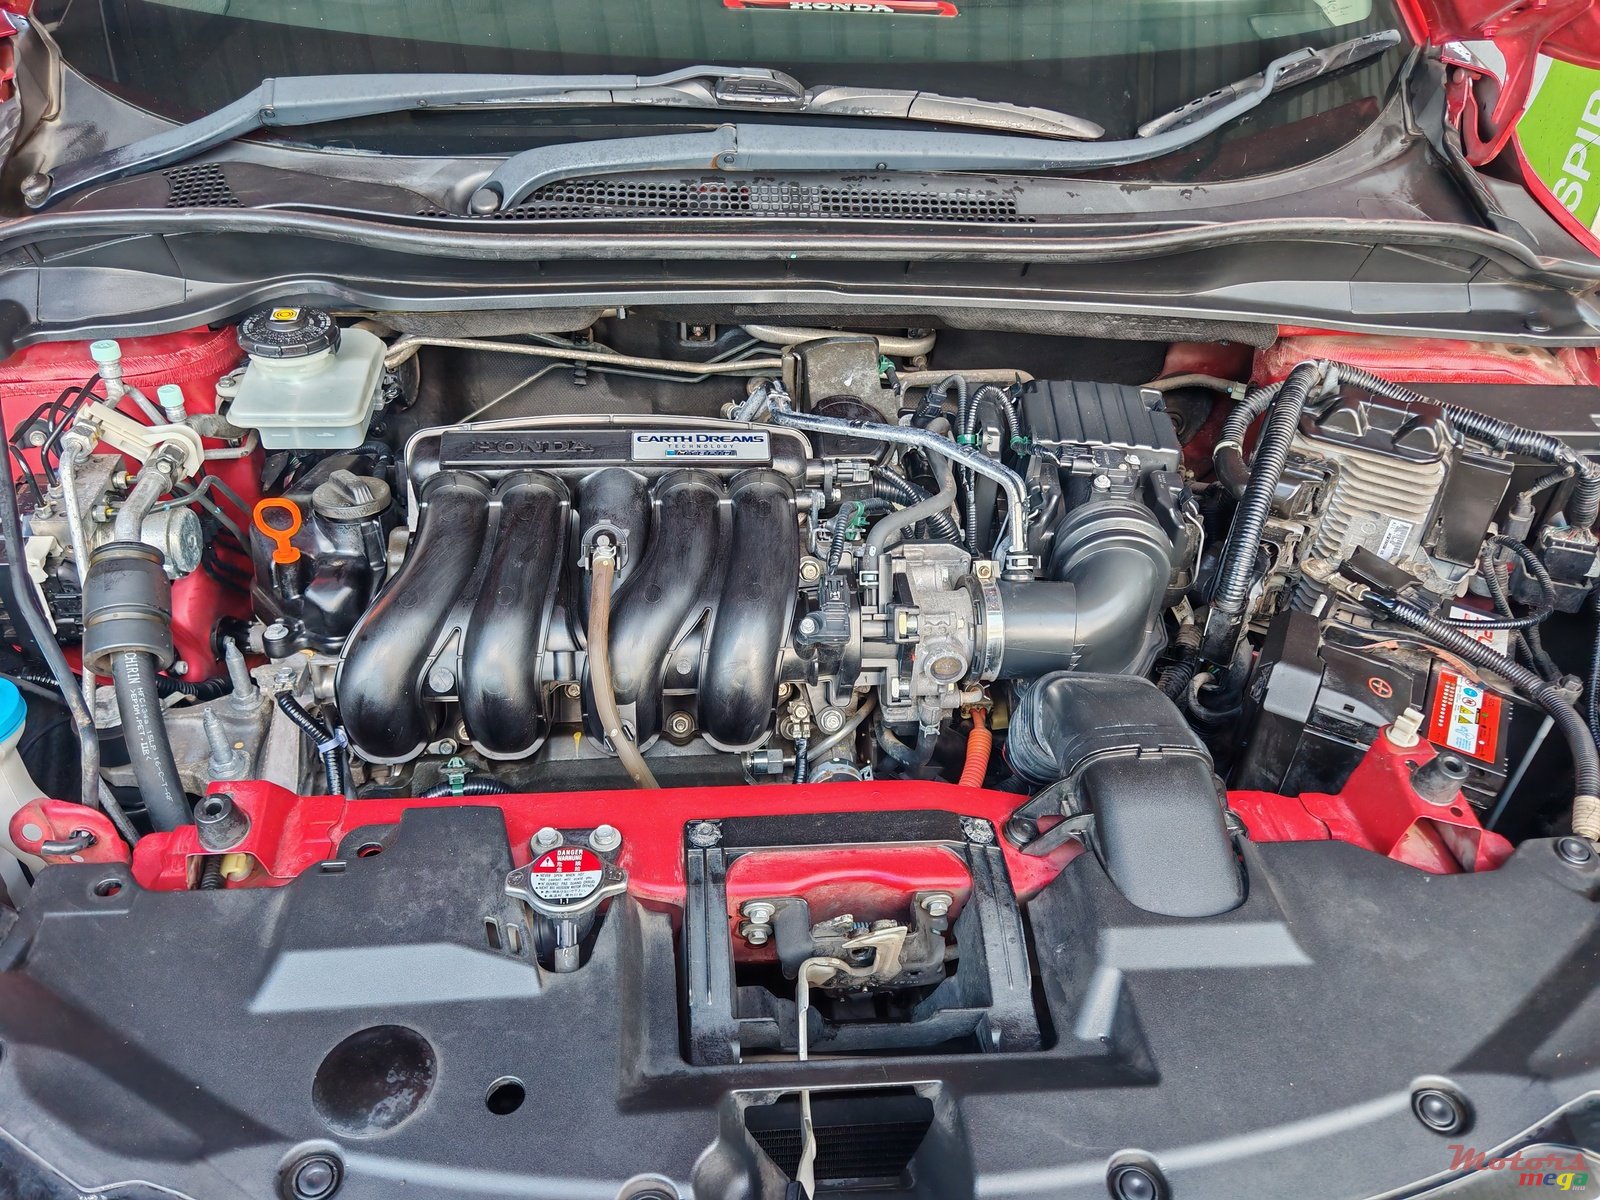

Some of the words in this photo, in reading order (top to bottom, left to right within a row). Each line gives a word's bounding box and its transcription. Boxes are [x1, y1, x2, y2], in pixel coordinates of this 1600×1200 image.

[789, 1, 895, 13] HONDA
[637, 435, 693, 443] EARTH
[696, 434, 764, 443] DREAMS
[471, 440, 595, 454] HONDA
